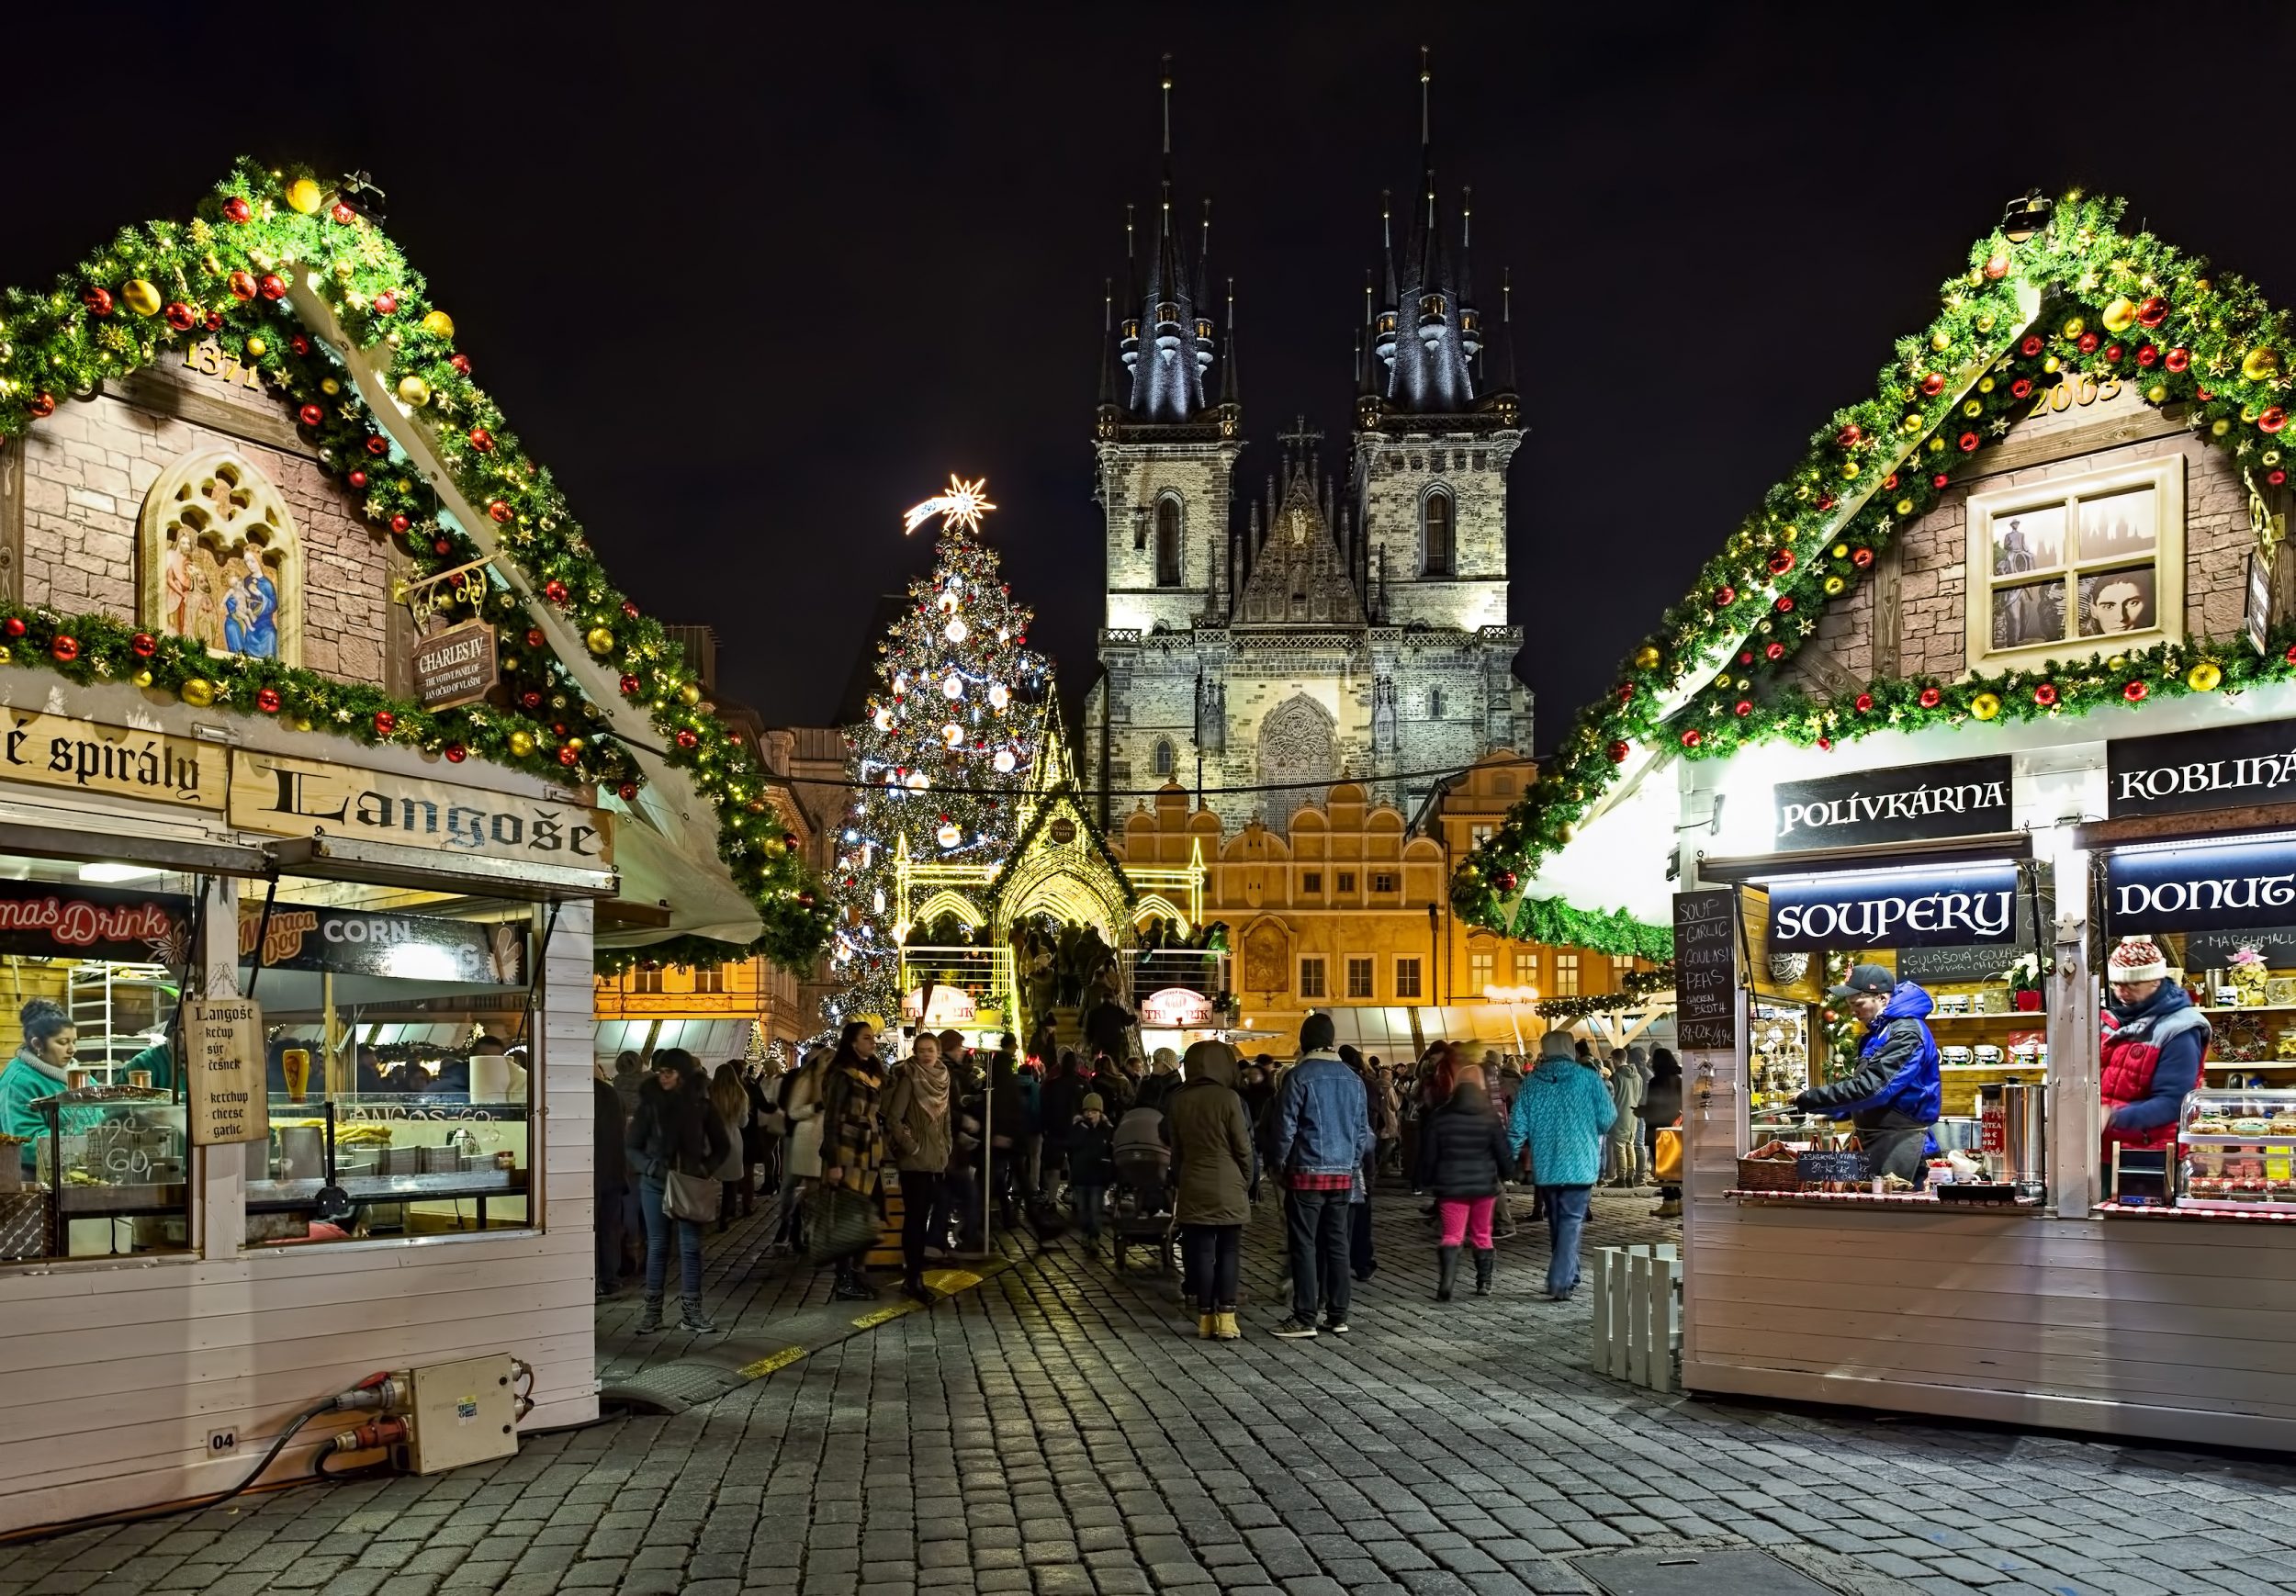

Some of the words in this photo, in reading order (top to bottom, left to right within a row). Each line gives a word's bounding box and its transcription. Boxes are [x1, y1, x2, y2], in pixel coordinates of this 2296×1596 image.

[419, 642, 469, 673] CHARLES
[470, 636, 484, 658] IV
[48, 737, 201, 802] spirály
[256, 764, 598, 856] Langoše
[1778, 781, 2007, 837] POLÍVKÁRNA
[2116, 874, 2296, 915] DONUT
[1679, 899, 1719, 922] SOUP
[1776, 892, 2013, 943] SOUPERY
[56, 905, 167, 941] Drink
[323, 919, 411, 943] CORN
[264, 929, 302, 966] Dog
[1684, 946, 1734, 968] GOULASH
[1685, 969, 1725, 991] PEAS
[195, 1005, 253, 1023] Langoše
[206, 1026, 233, 1040] kečup
[208, 1058, 242, 1071] česnek
[210, 1091, 249, 1104] ketchup
[212, 1107, 244, 1120] cheese
[212, 1433, 234, 1450] 04
